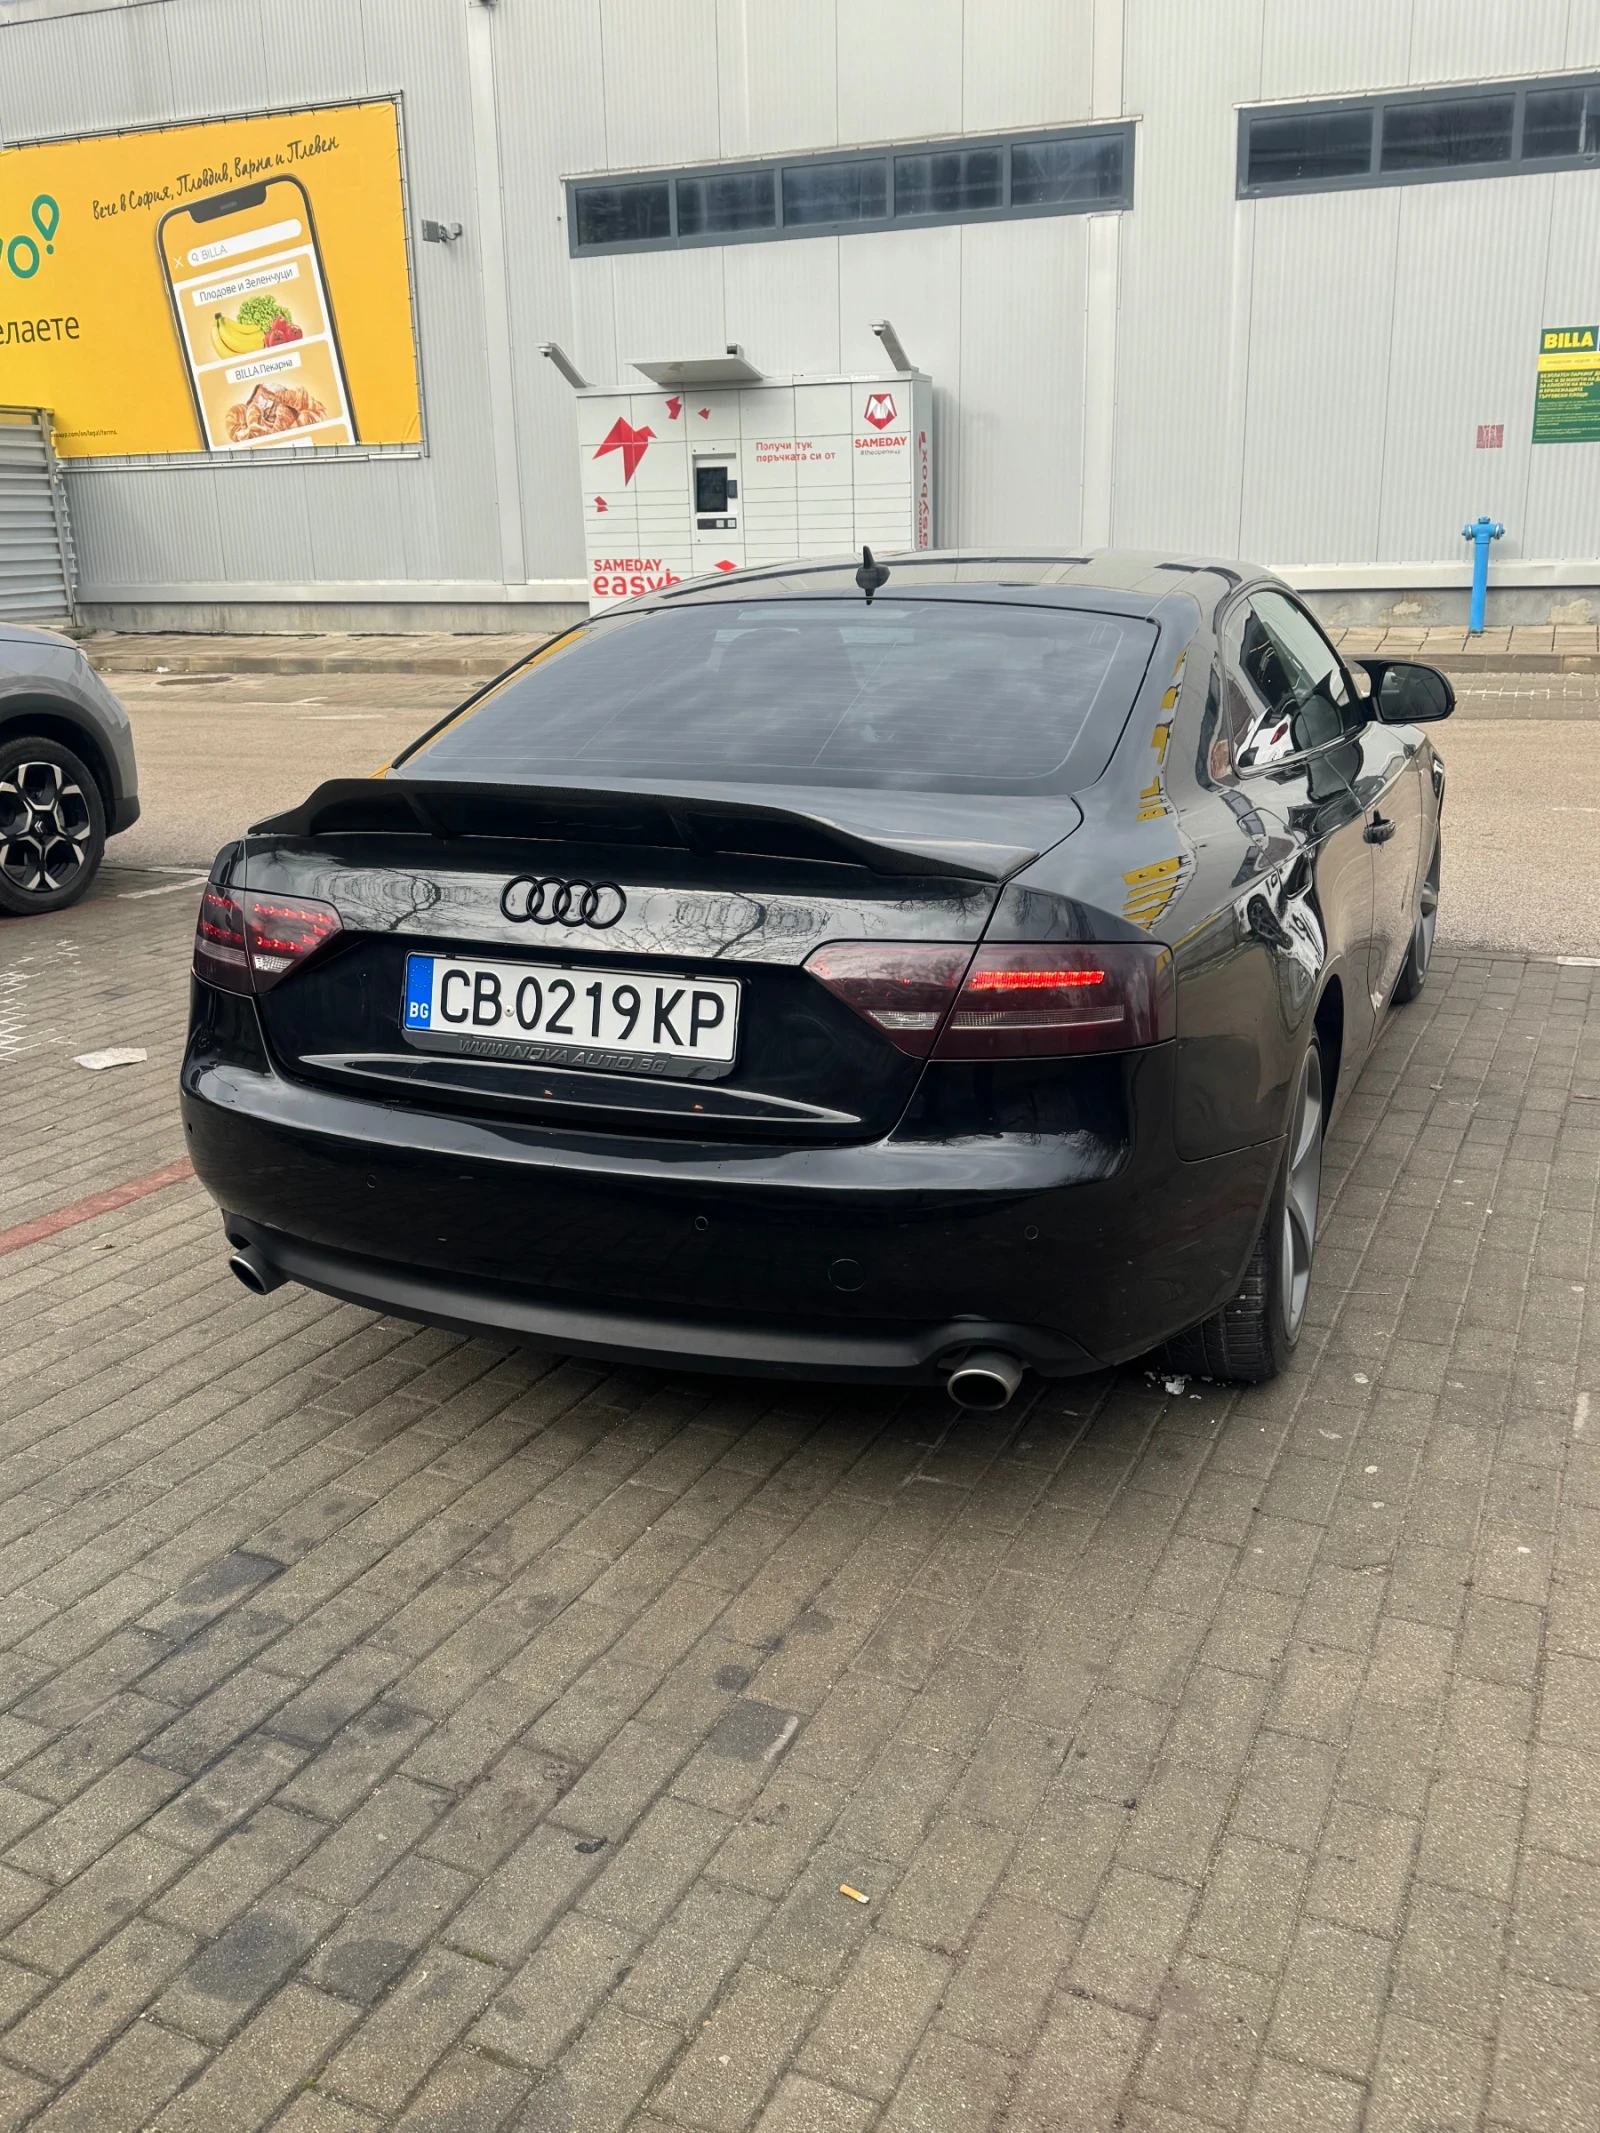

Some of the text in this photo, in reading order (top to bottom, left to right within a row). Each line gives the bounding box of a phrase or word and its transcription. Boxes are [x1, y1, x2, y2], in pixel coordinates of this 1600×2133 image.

[129, 186, 174, 210] София,
[176, 163, 233, 196] Пловдив,
[234, 157, 273, 179] Варна
[275, 153, 285, 165] и
[286, 134, 340, 164] Плевен
[201, 245, 227, 261] BILLA
[200, 268, 293, 302] Плодове и Зеленчуци
[1544, 332, 1594, 349] BILLA
[235, 358, 293, 380] BILLA Пекарна
[756, 440, 813, 452] Получи тук
[854, 436, 907, 448] SAMEDAY
[756, 452, 836, 464] поръчката си от
[593, 559, 662, 572] SAMEDAY
[409, 1001, 430, 1019] BG
